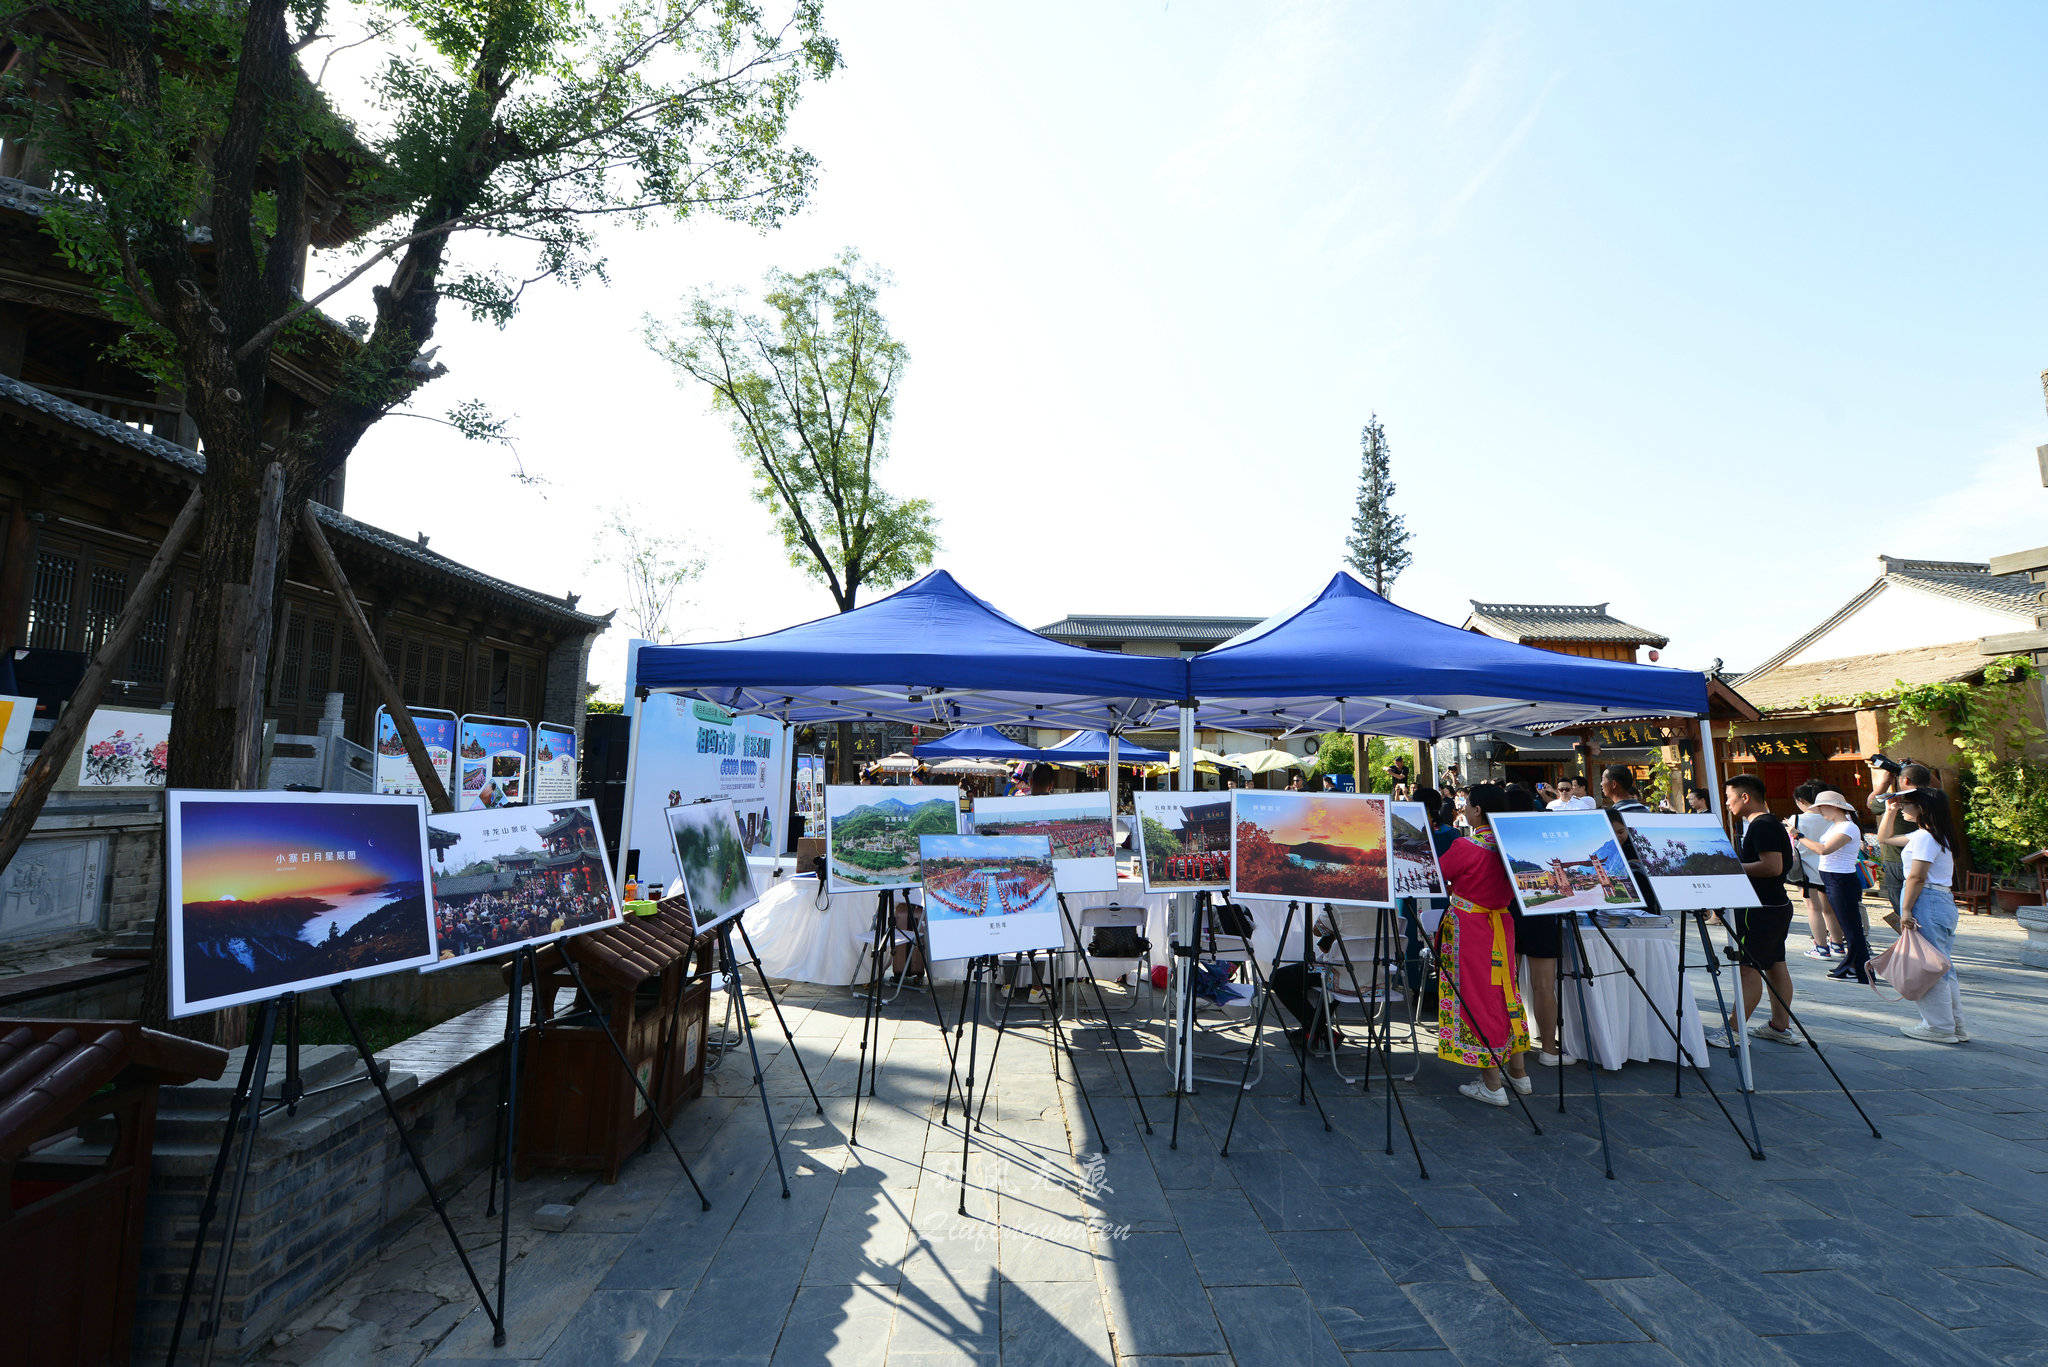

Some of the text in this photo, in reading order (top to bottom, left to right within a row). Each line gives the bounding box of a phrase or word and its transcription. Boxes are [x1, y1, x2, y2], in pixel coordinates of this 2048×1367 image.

[482, 825, 528, 837] 寻龙山景区
